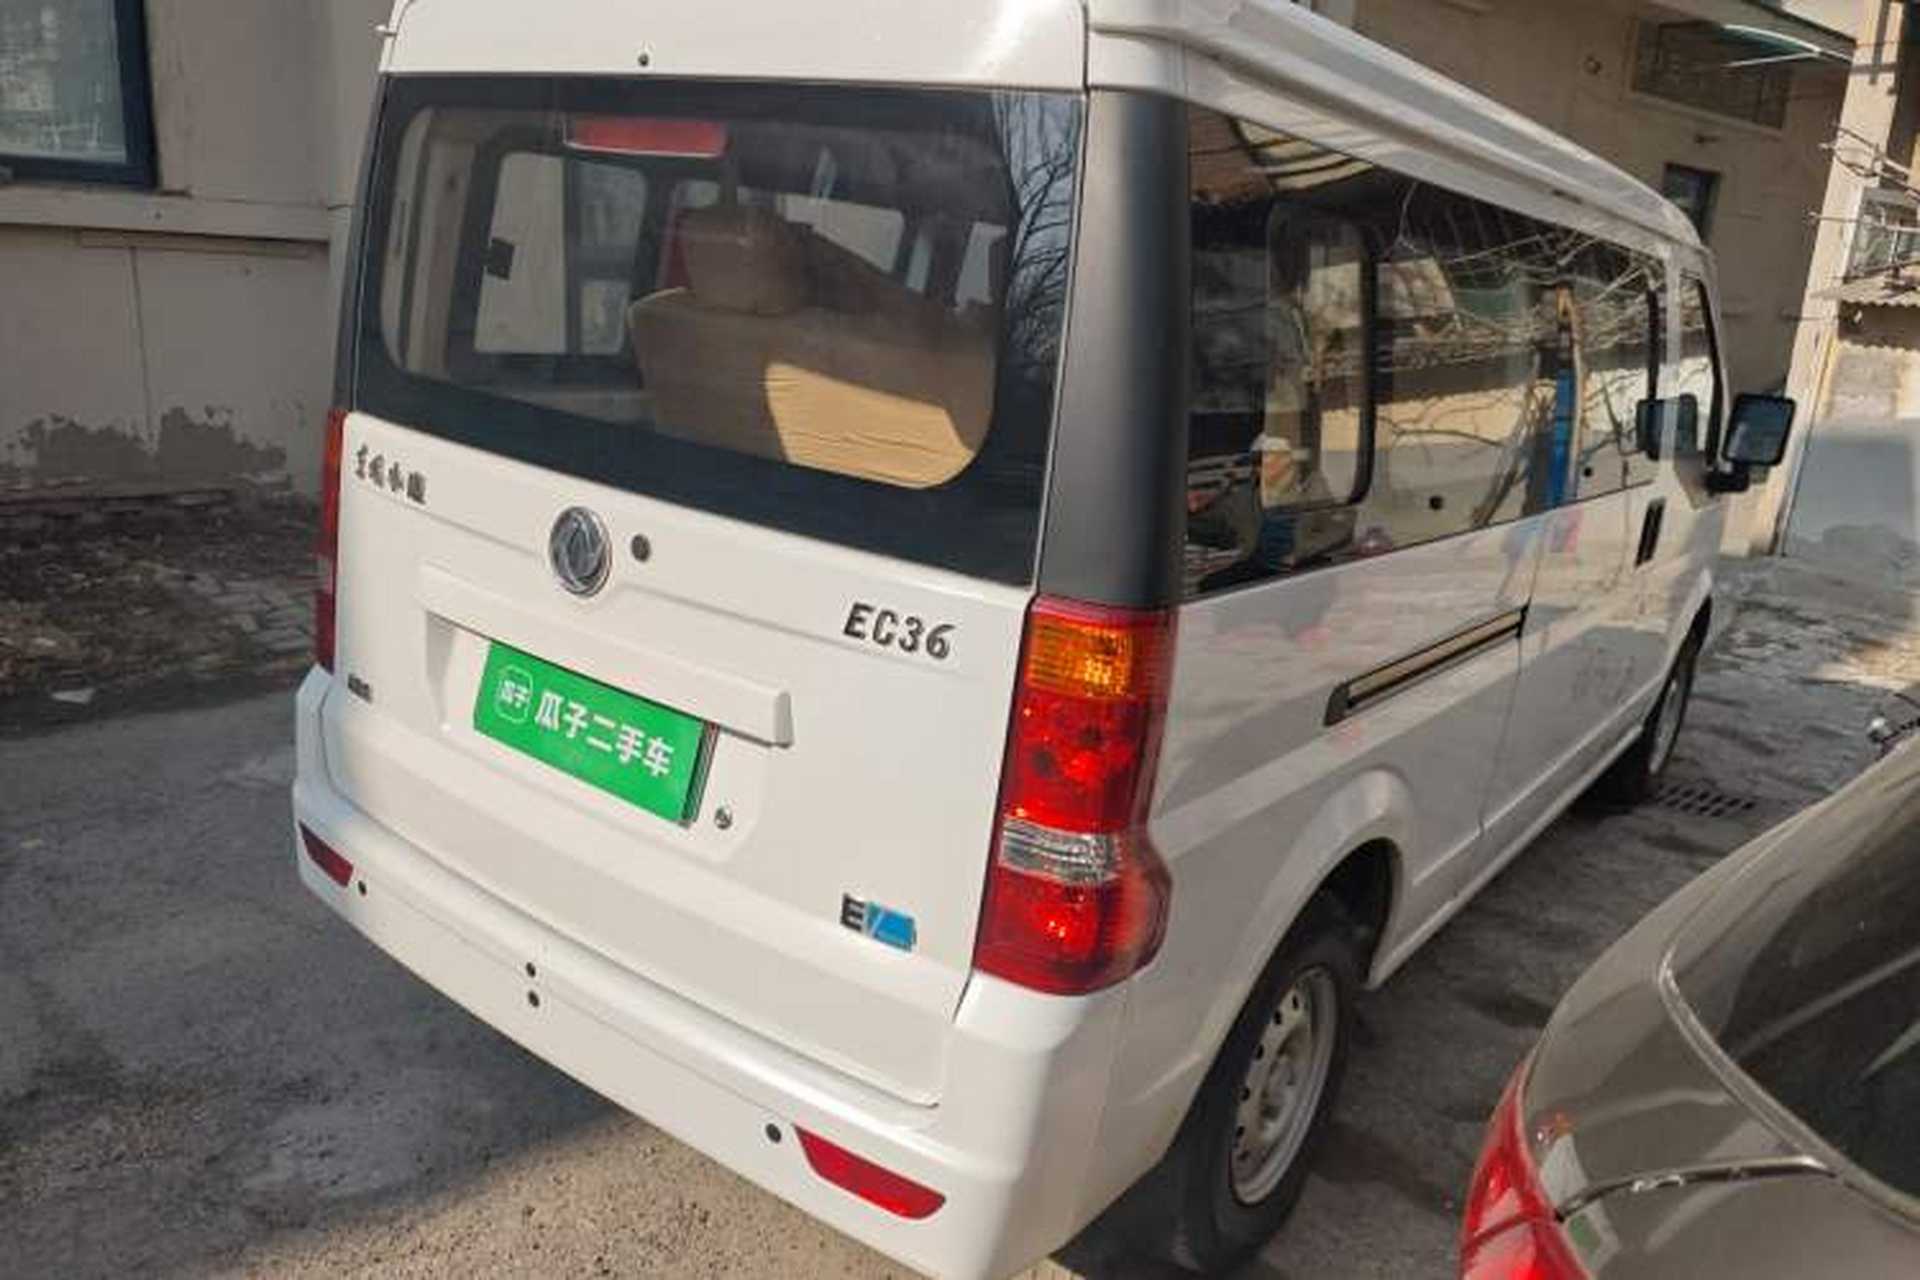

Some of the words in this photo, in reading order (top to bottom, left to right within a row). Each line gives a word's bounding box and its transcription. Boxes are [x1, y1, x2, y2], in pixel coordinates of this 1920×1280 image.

[843, 602, 956, 660] EC36
[534, 688, 675, 778] 瓜子二手车
